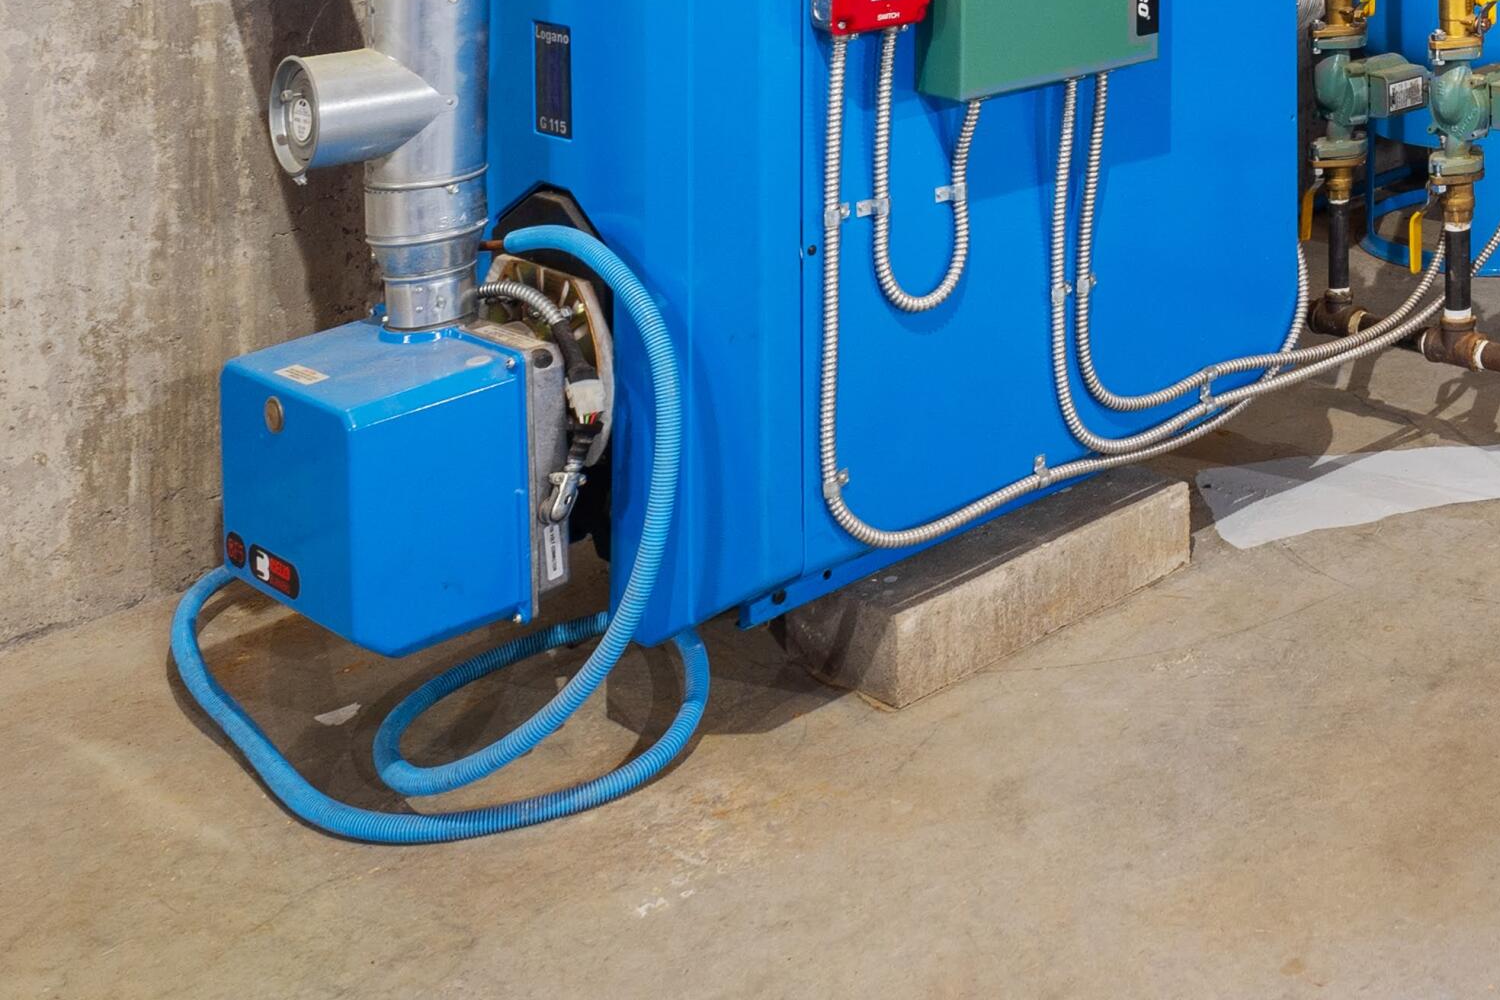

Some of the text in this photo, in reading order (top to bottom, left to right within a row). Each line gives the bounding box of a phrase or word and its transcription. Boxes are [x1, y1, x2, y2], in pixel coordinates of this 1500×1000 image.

[877, 12, 900, 21] SWITCH
[535, 25, 569, 44] Logano
[549, 119, 567, 134] 115
